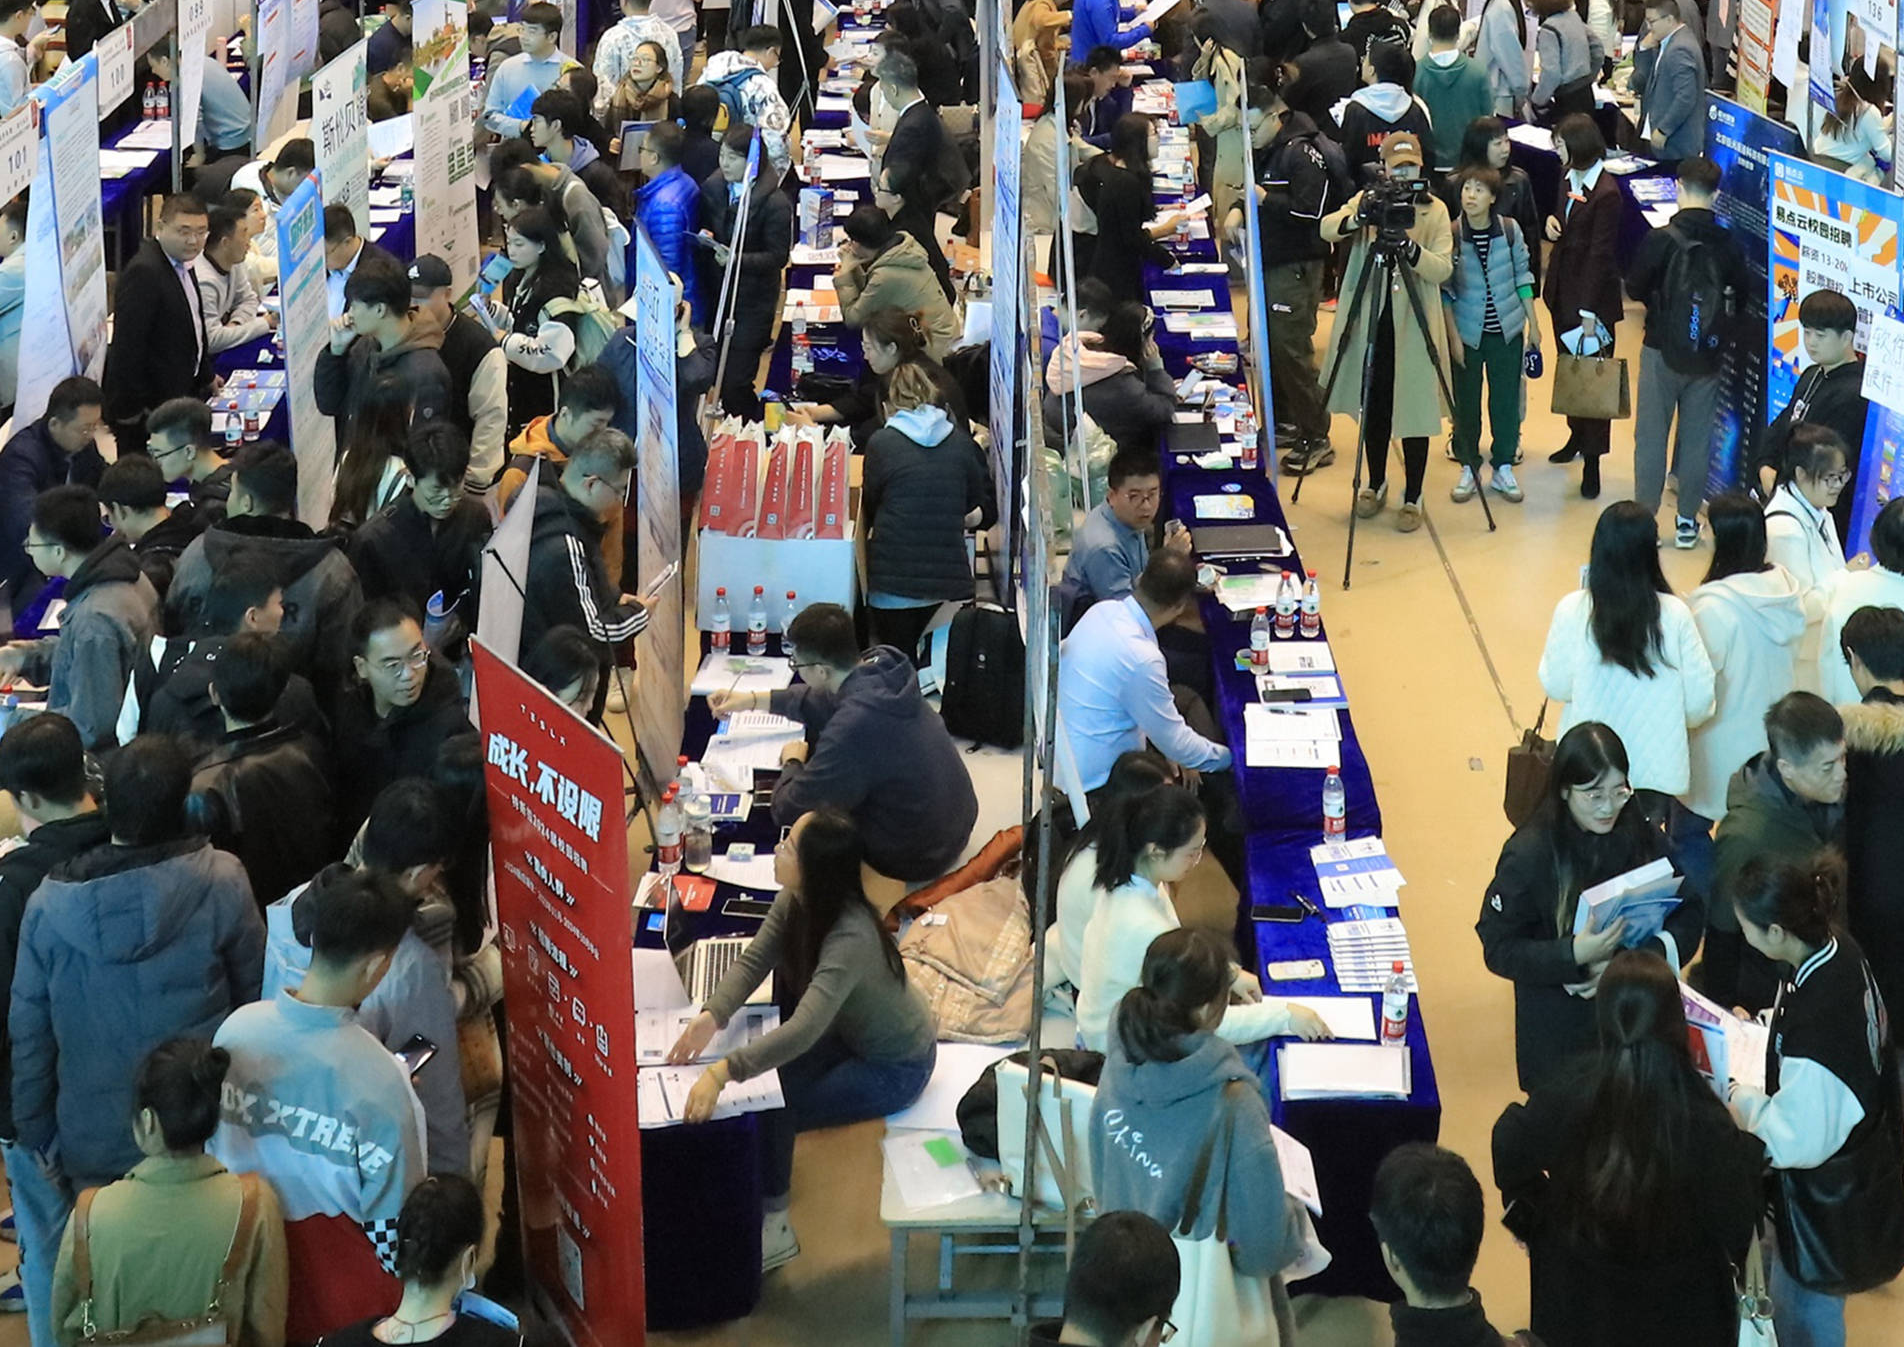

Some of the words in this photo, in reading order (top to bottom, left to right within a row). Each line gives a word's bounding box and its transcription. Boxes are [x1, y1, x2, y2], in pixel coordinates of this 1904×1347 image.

[1862, 0, 1883, 28] 136
[7, 146, 27, 175] 101
[1774, 205, 1854, 249] 易点云校园招聘
[1848, 277, 1900, 307] 上市公司
[520, 704, 566, 747] TESLA
